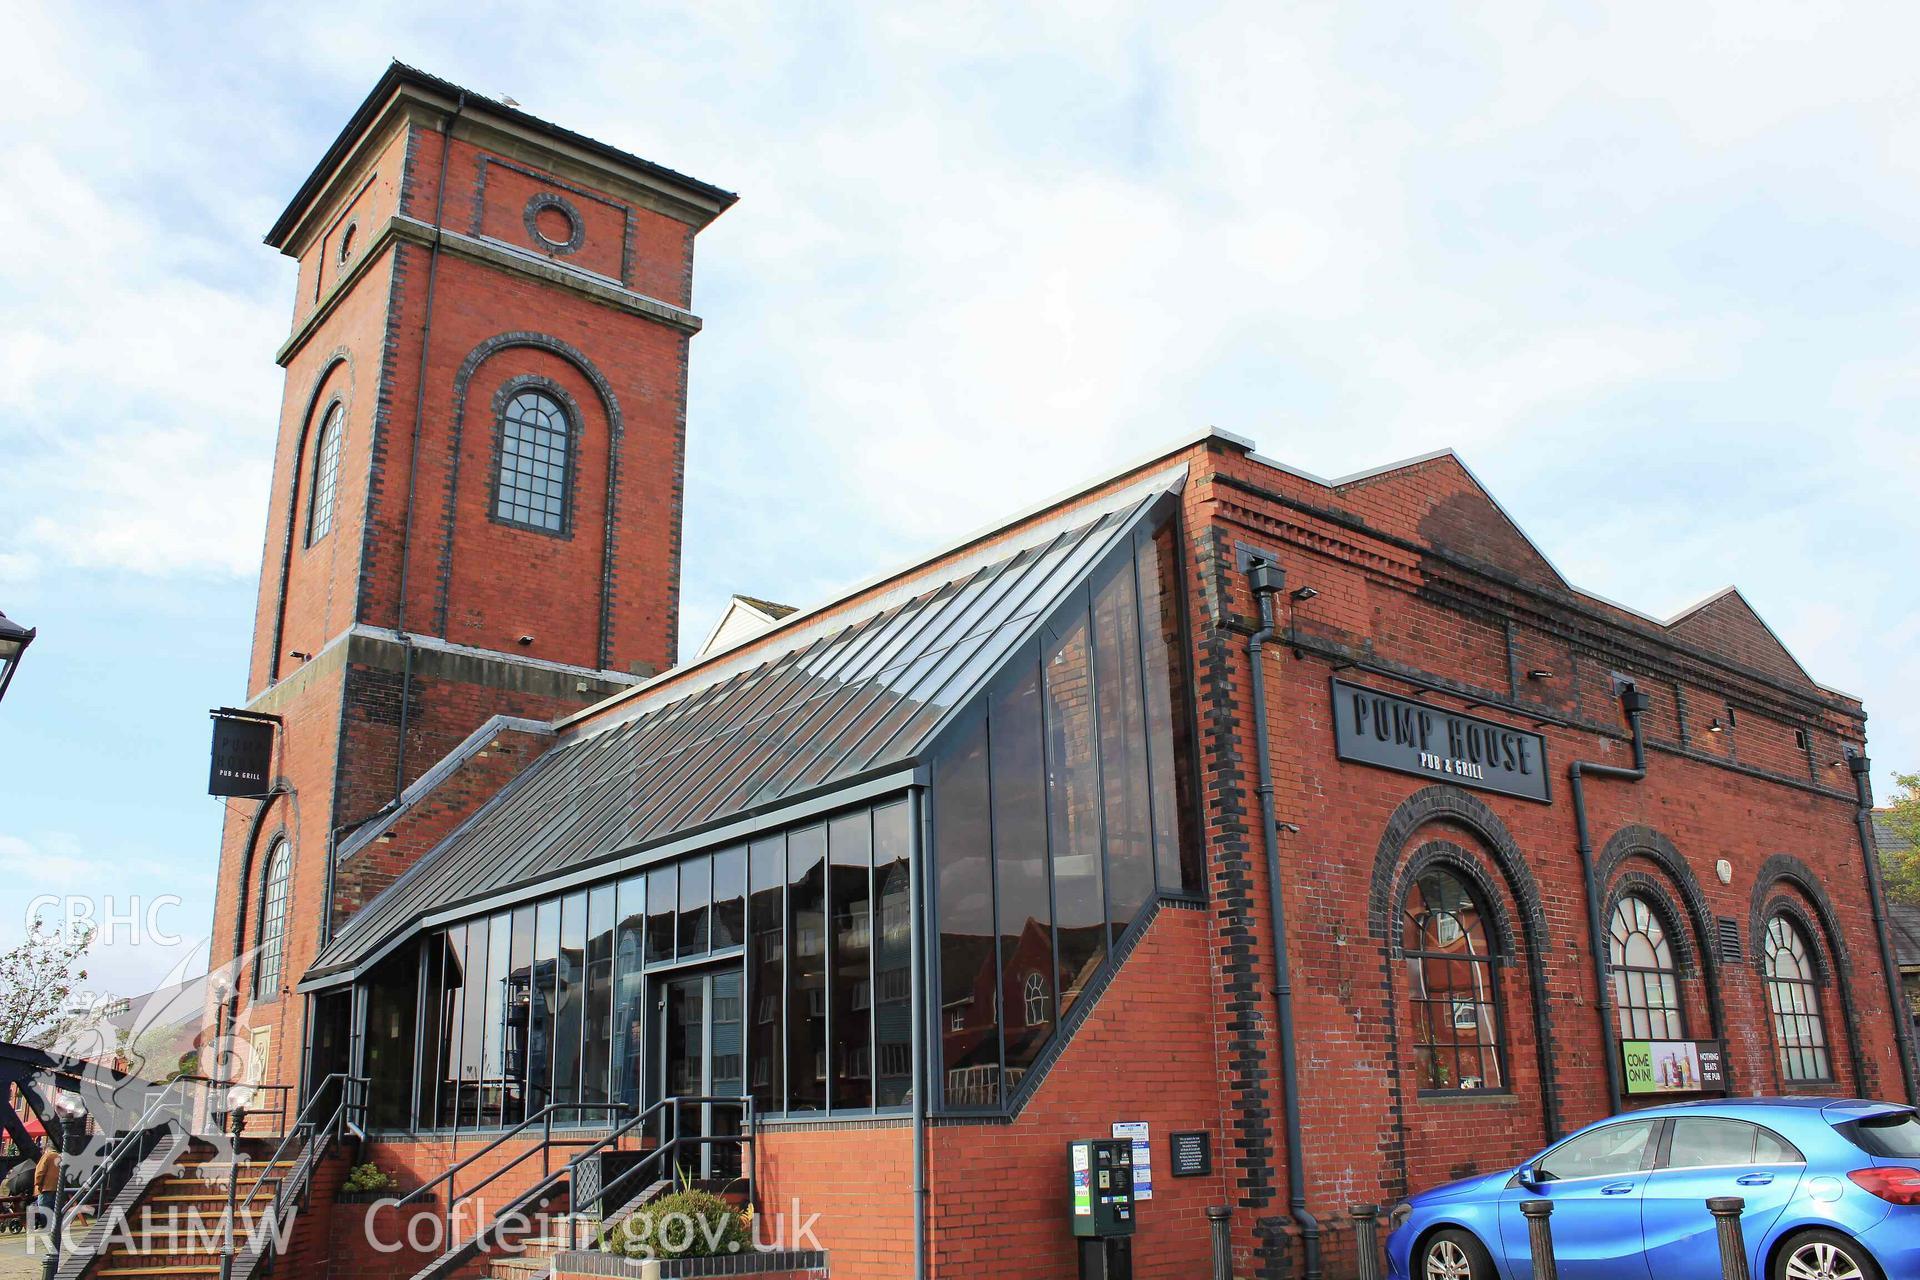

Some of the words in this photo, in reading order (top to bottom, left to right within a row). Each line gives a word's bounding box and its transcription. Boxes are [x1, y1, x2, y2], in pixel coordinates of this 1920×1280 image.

[1354, 693, 1434, 750] PUMP
[1448, 718, 1532, 775] HOUSE
[1419, 753, 1440, 770] PUB
[1444, 759, 1452, 773] &
[1454, 759, 1484, 780] GRILL
[242, 772, 260, 780] GRILL
[1627, 1054, 1649, 1067] COME
[1628, 1069, 1640, 1082] ON
[1641, 1069, 1652, 1082] IN!
[1703, 1072, 1712, 1080] THE
